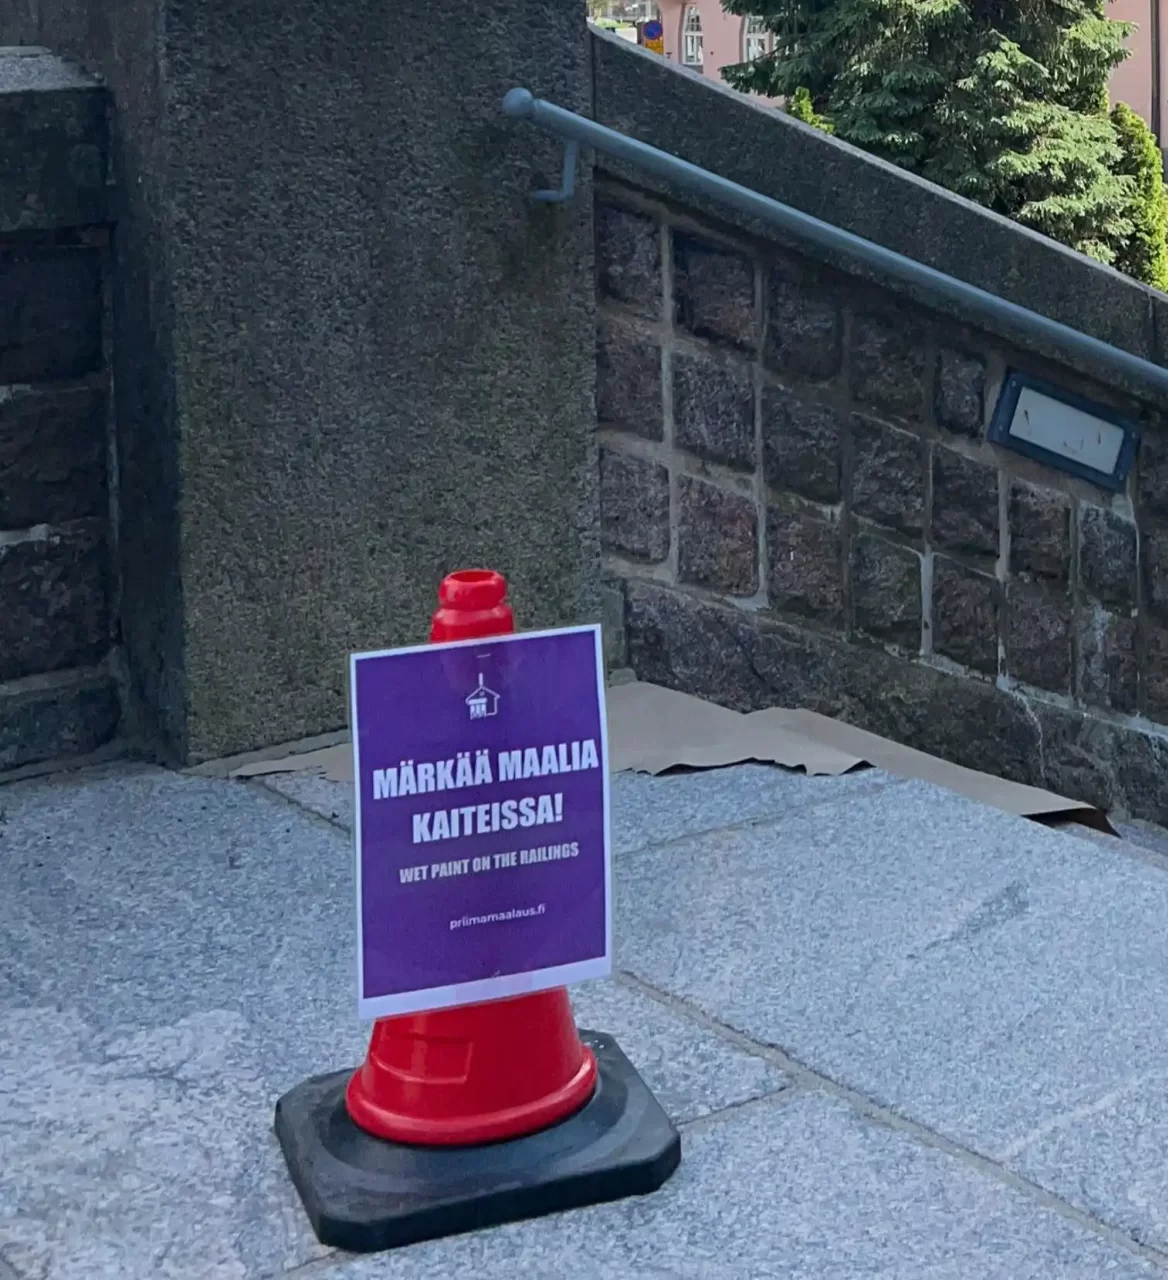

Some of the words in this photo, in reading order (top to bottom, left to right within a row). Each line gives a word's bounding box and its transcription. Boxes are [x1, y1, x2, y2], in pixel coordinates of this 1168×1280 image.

[373, 749, 493, 800] MÄRKÄÄ
[498, 739, 599, 782] MAALIA
[412, 792, 563, 844] KAITEISSA!
[400, 865, 428, 883] WET
[431, 859, 470, 879] PAINT
[472, 856, 490, 872] ON
[494, 851, 517, 869] THE
[520, 842, 579, 865] RAILINGS
[449, 903, 547, 930] priimamaalaus.fi
